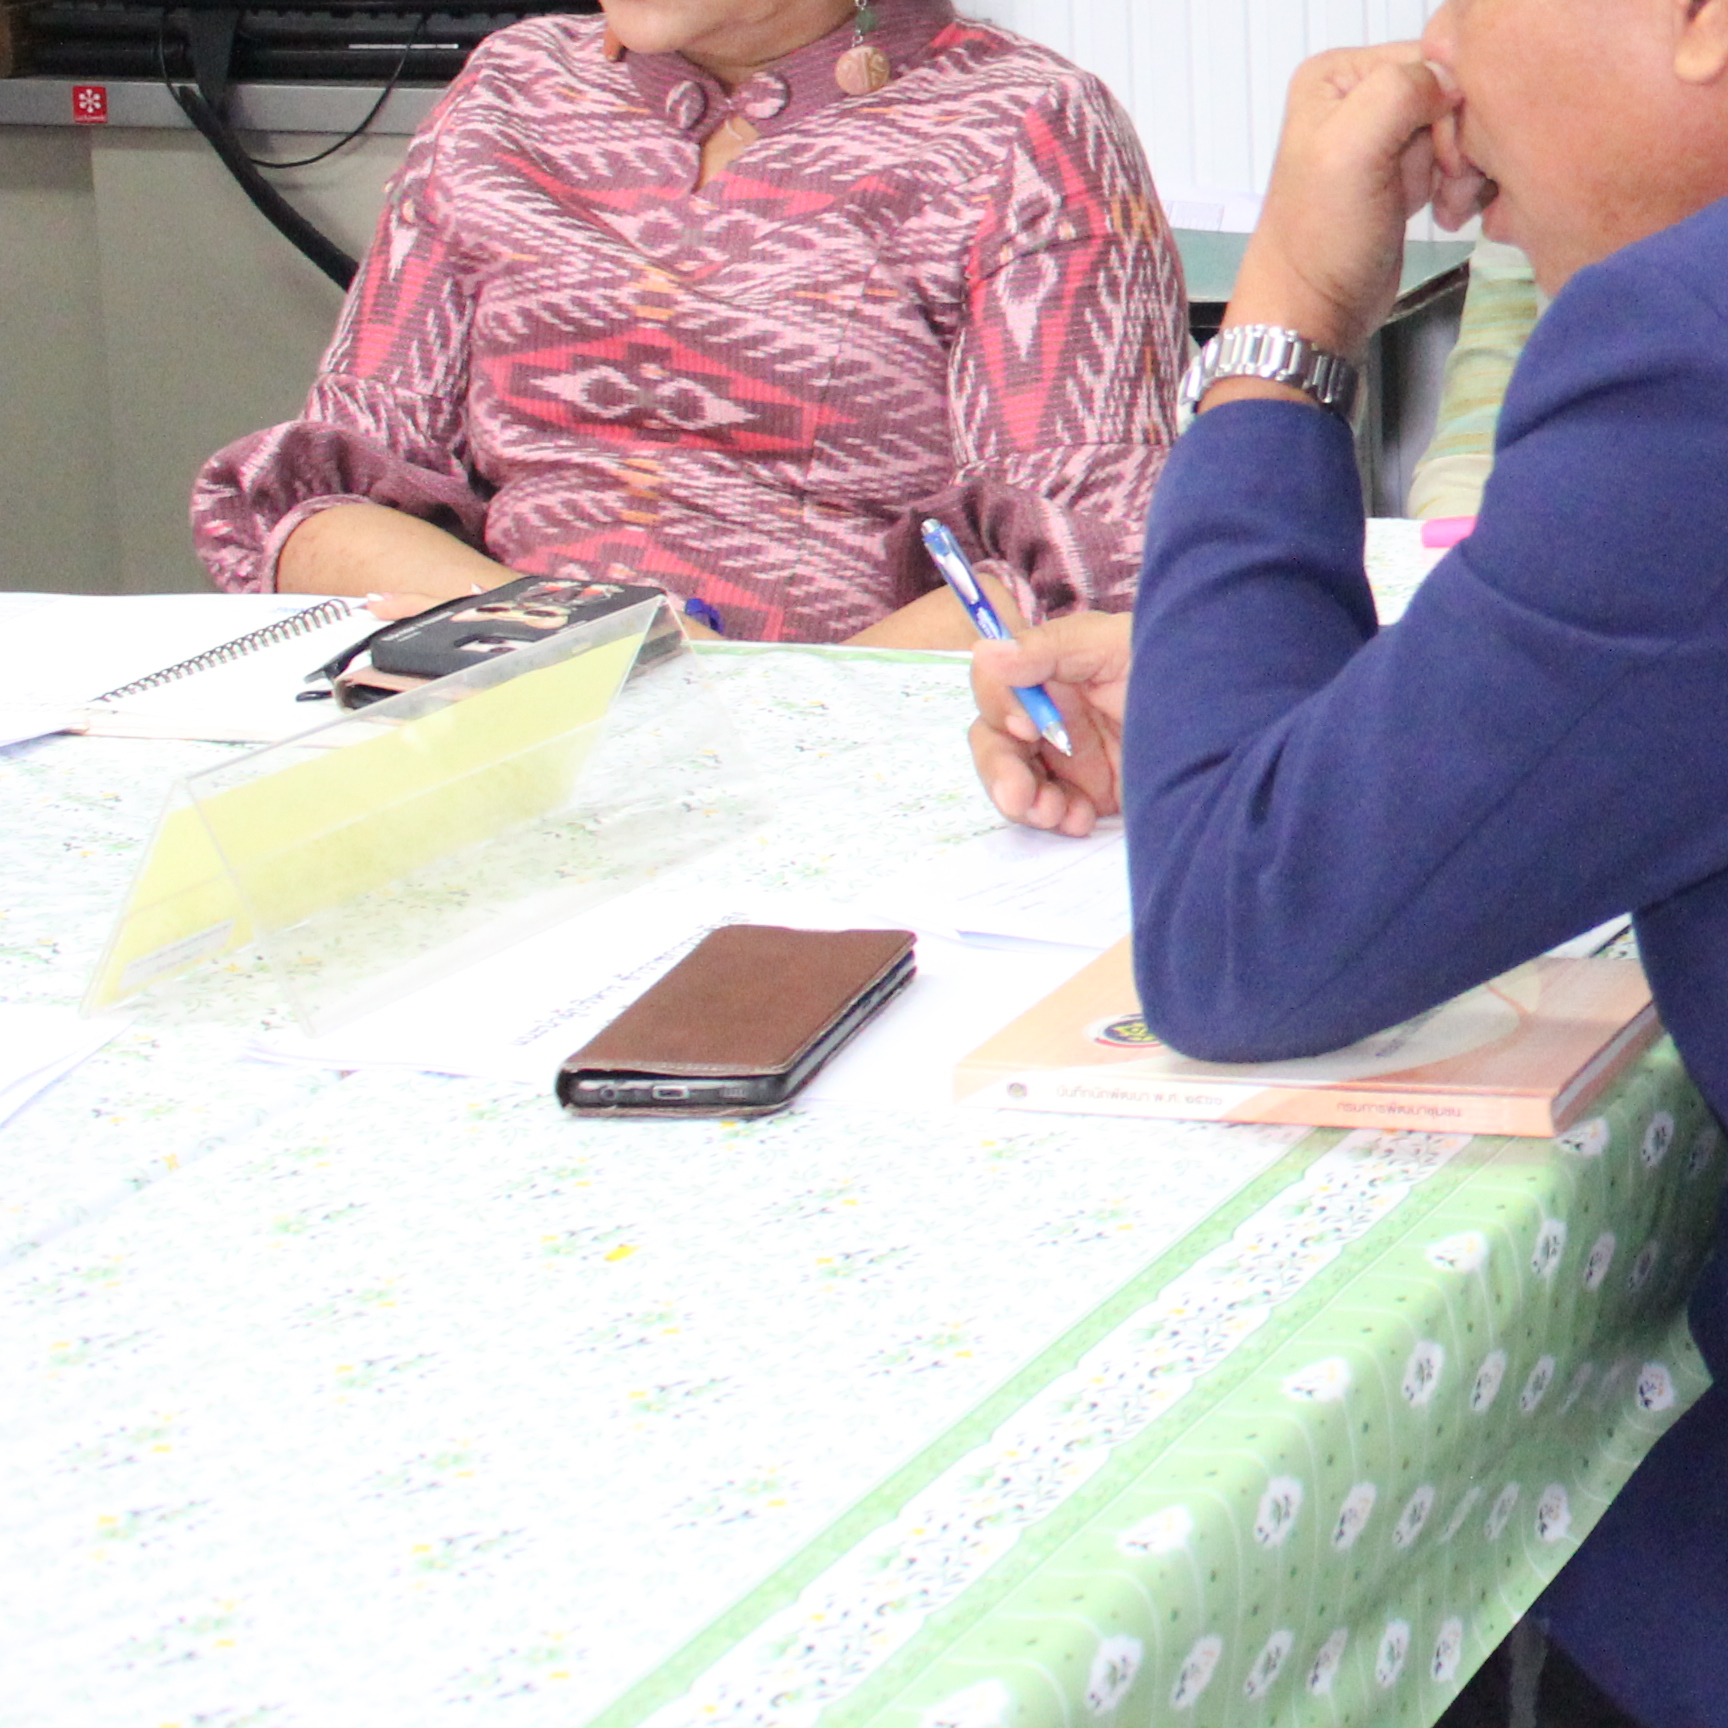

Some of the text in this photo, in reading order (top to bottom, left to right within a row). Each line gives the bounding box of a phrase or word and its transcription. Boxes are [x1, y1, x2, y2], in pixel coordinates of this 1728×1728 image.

[1336, 1101, 1462, 1122] กรมการพัฒนาชุมชน
